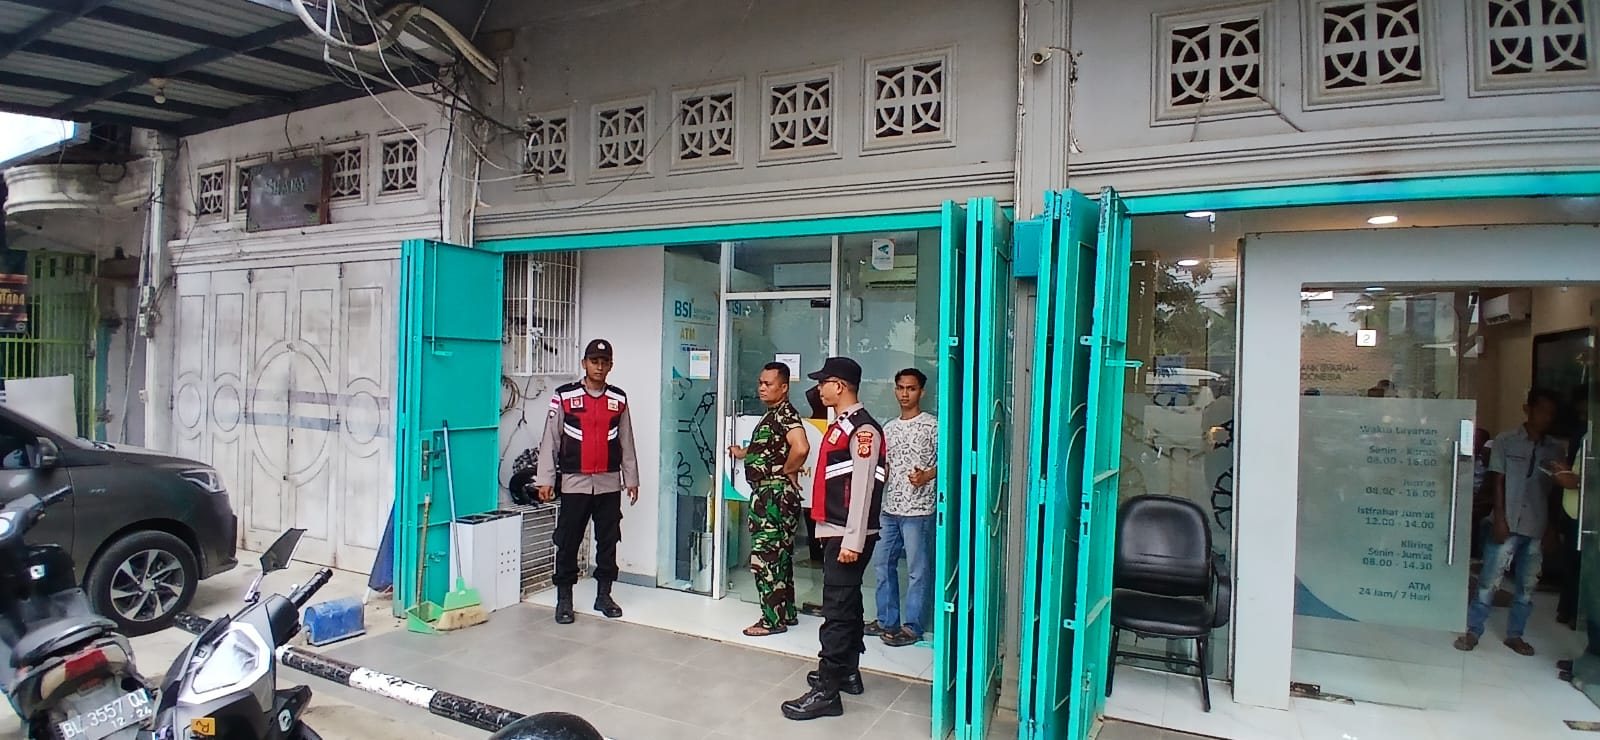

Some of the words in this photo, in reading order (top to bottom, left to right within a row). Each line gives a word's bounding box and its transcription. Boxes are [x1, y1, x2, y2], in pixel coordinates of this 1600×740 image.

[675, 300, 692, 318] BSI
[680, 327, 696, 341] ATM
[1363, 334, 1371, 344] 2
[1369, 445, 1397, 455] Senin
[1366, 516, 1395, 527] 12.00
[1405, 520, 1434, 529] 14.00
[1401, 540, 1433, 552] Kliring
[1368, 547, 1394, 557] Senin
[1401, 550, 1433, 560] Jum'at
[1362, 557, 1393, 567] 08.00
[1403, 560, 1433, 570] 14.30
[1408, 581, 1431, 591] ATM
[1359, 587, 1371, 595] 24
[1401, 591, 1407, 599] 7
[1410, 592, 1431, 601] Hari
[63, 716, 85, 738] BL
[87, 700, 124, 727] 3557
